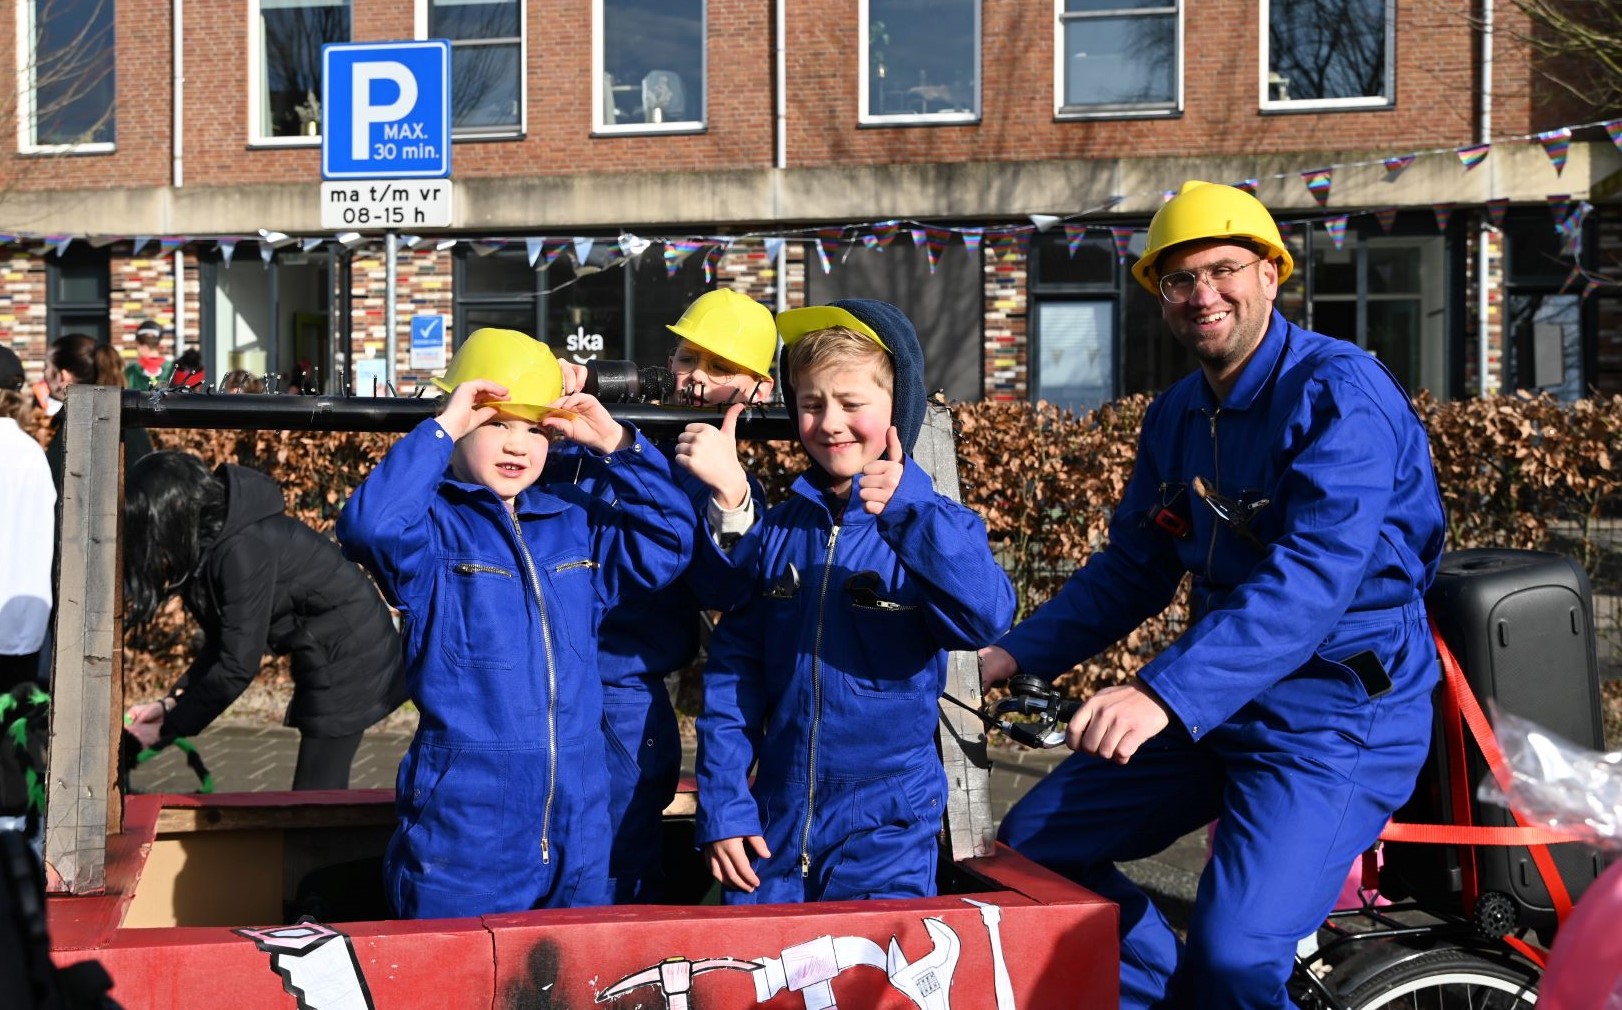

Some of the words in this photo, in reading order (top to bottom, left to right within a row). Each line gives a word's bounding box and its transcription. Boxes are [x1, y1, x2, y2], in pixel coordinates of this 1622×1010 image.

[352, 61, 418, 160] P
[384, 123, 428, 140] MAX.
[374, 144, 397, 160] 30
[402, 143, 440, 159] min.
[331, 189, 359, 202] ma
[370, 184, 409, 202] t/m
[420, 188, 441, 201] vr
[343, 207, 405, 224] 08-15
[415, 207, 425, 223] h
[566, 326, 604, 351] ska
